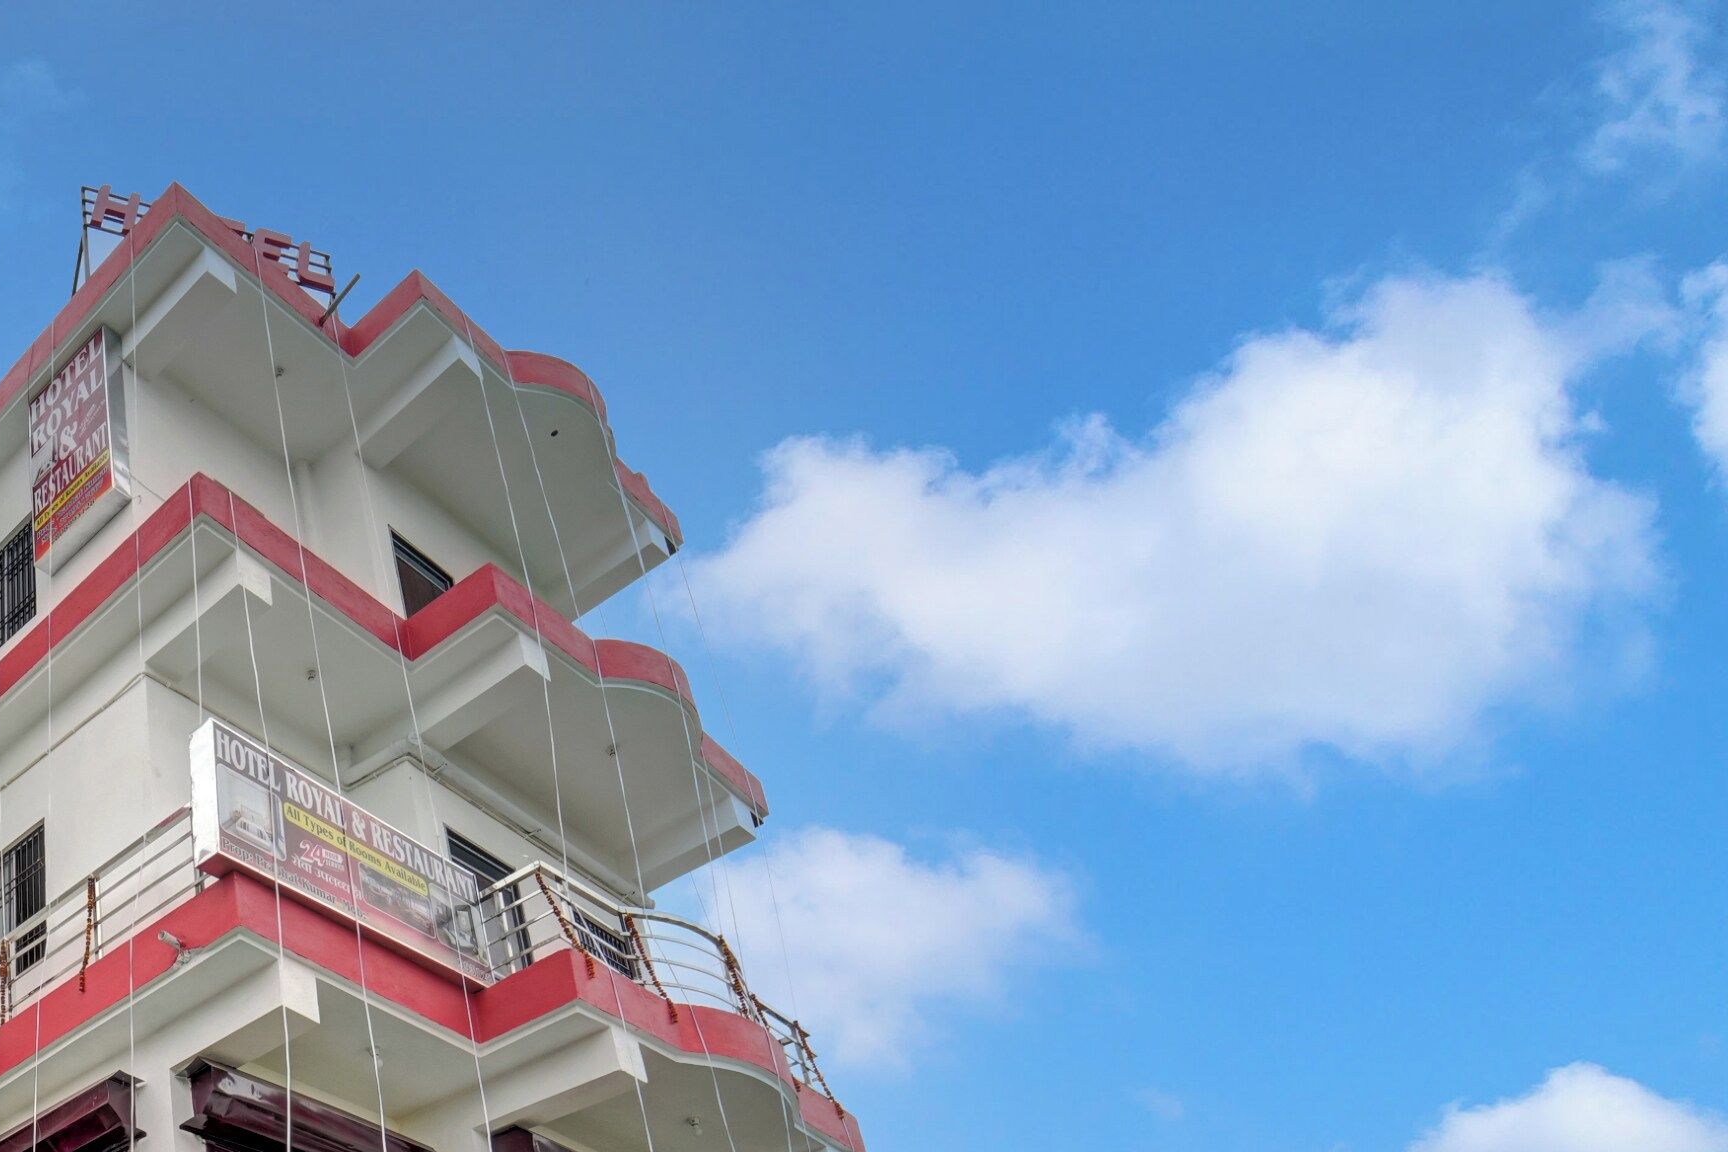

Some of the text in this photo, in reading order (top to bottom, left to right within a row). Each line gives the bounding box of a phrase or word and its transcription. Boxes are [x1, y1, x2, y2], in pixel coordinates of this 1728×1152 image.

[90, 184, 334, 293] HEL
[31, 338, 103, 425] HOTEL
[32, 367, 104, 454] ROYAL
[34, 421, 107, 517] RESTAURANT
[59, 421, 78, 459] &
[215, 729, 476, 904] HOTEL ROYAL & RESTAURANT
[287, 806, 300, 821] All
[304, 815, 334, 840] Types
[337, 835, 346, 847] of
[348, 841, 382, 867] Rooms
[385, 863, 427, 892] Available
[299, 839, 325, 867] 24
